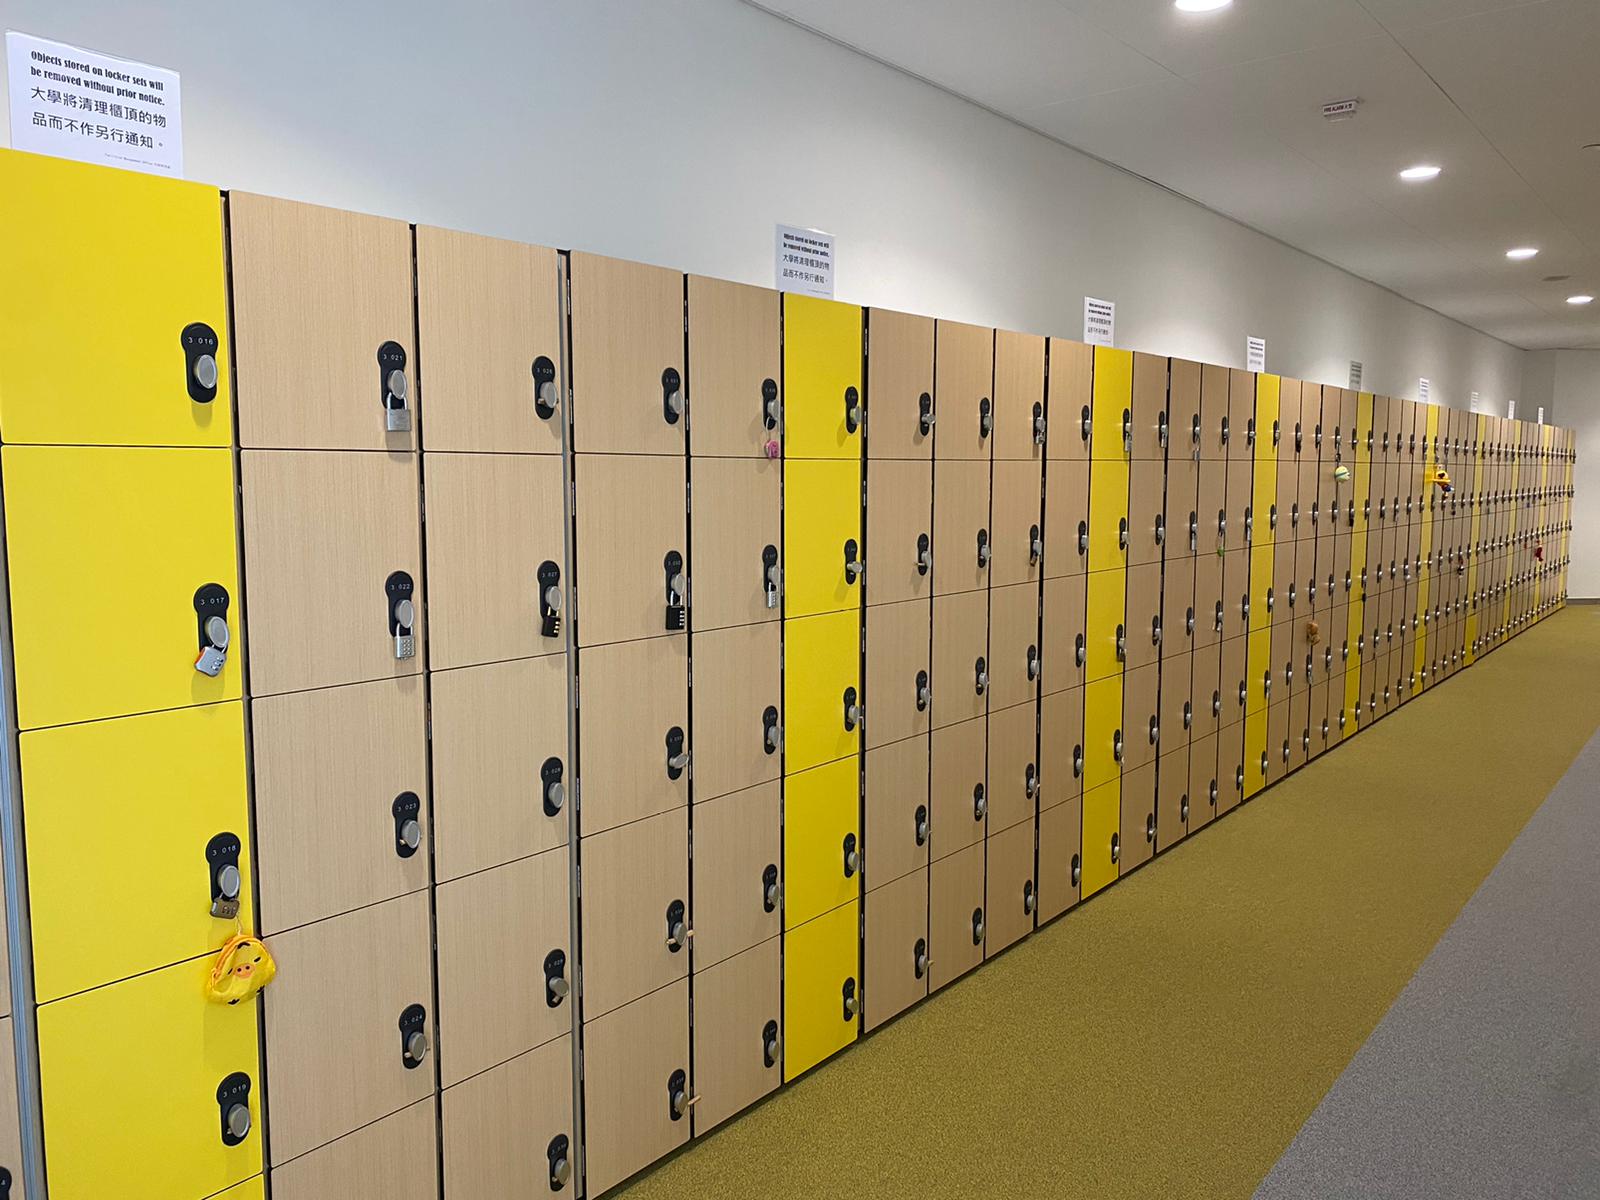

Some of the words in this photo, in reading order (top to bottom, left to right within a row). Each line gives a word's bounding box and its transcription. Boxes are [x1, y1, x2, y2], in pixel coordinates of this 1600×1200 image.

[31, 51, 62, 66] Objects
[64, 60, 90, 73] stored
[92, 67, 103, 76] on
[105, 69, 130, 83] locker
[132, 77, 147, 87] sets
[148, 81, 164, 91] will
[31, 66, 41, 77] be
[44, 71, 81, 86] removed
[84, 80, 115, 94] without
[116, 88, 137, 99] prior
[139, 93, 165, 106] notice.
[31, 86, 167, 128] 大學將清理櫃頂的物
[210, 597, 225, 605] 017
